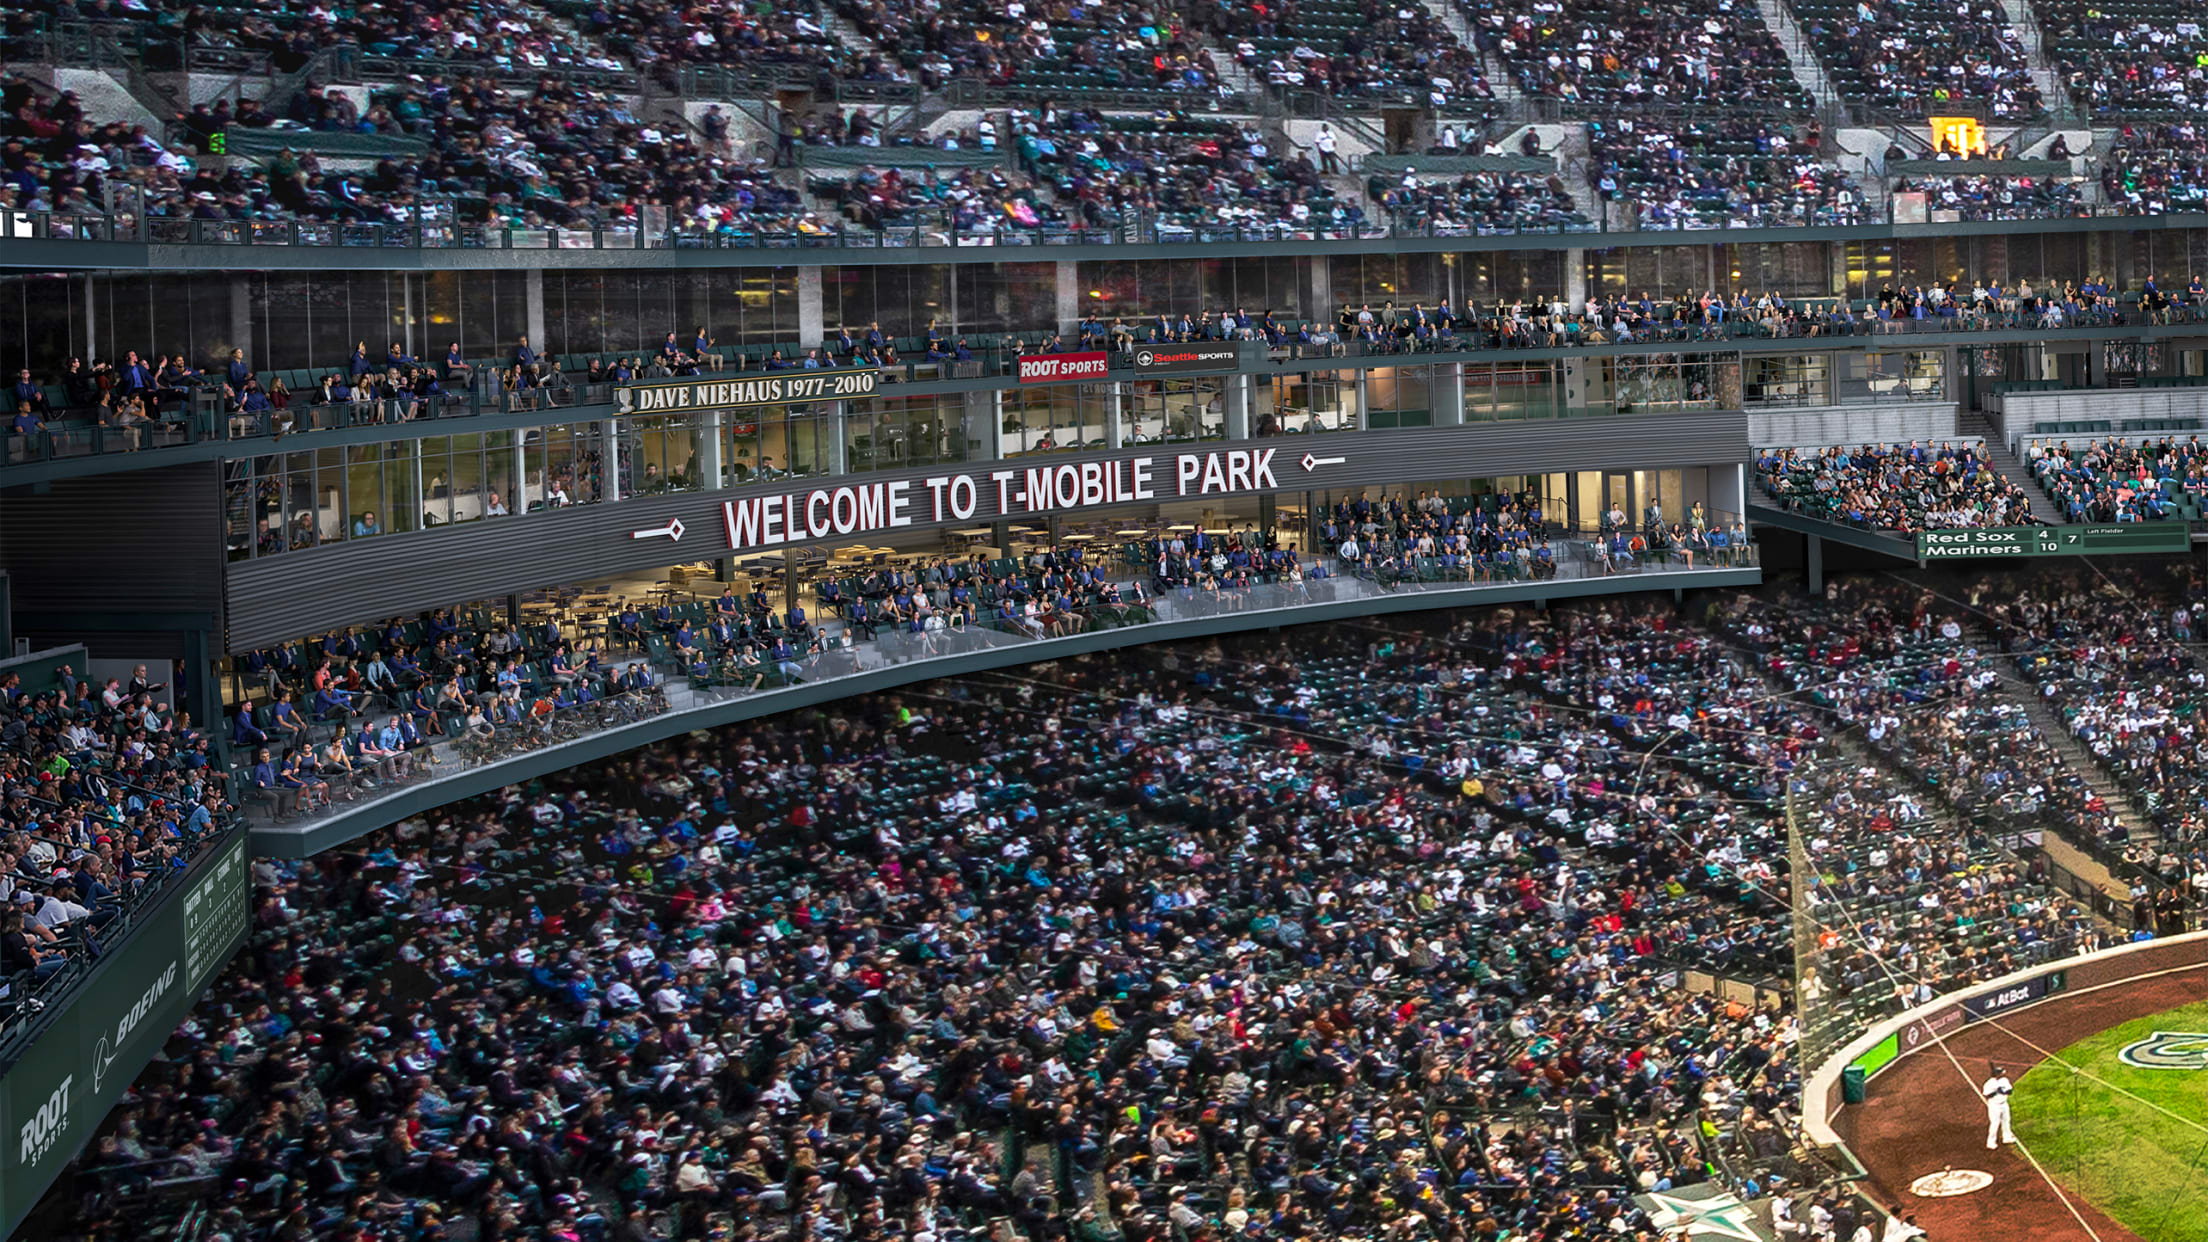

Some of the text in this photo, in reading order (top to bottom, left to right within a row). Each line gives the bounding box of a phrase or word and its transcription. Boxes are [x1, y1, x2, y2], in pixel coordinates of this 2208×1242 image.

[1021, 360, 1060, 377] ROOT
[640, 374, 875, 410] DAVE NIEHAUS 1977-2010
[721, 448, 1278, 549] WELCOME TO T-MOBILE PARK
[1926, 530, 2048, 544] Red Sox 4
[1926, 542, 2057, 556] Mariners 10
[2068, 535, 2077, 544] 7
[115, 961, 177, 1047] BOEING
[20, 1073, 73, 1166] ROOT
